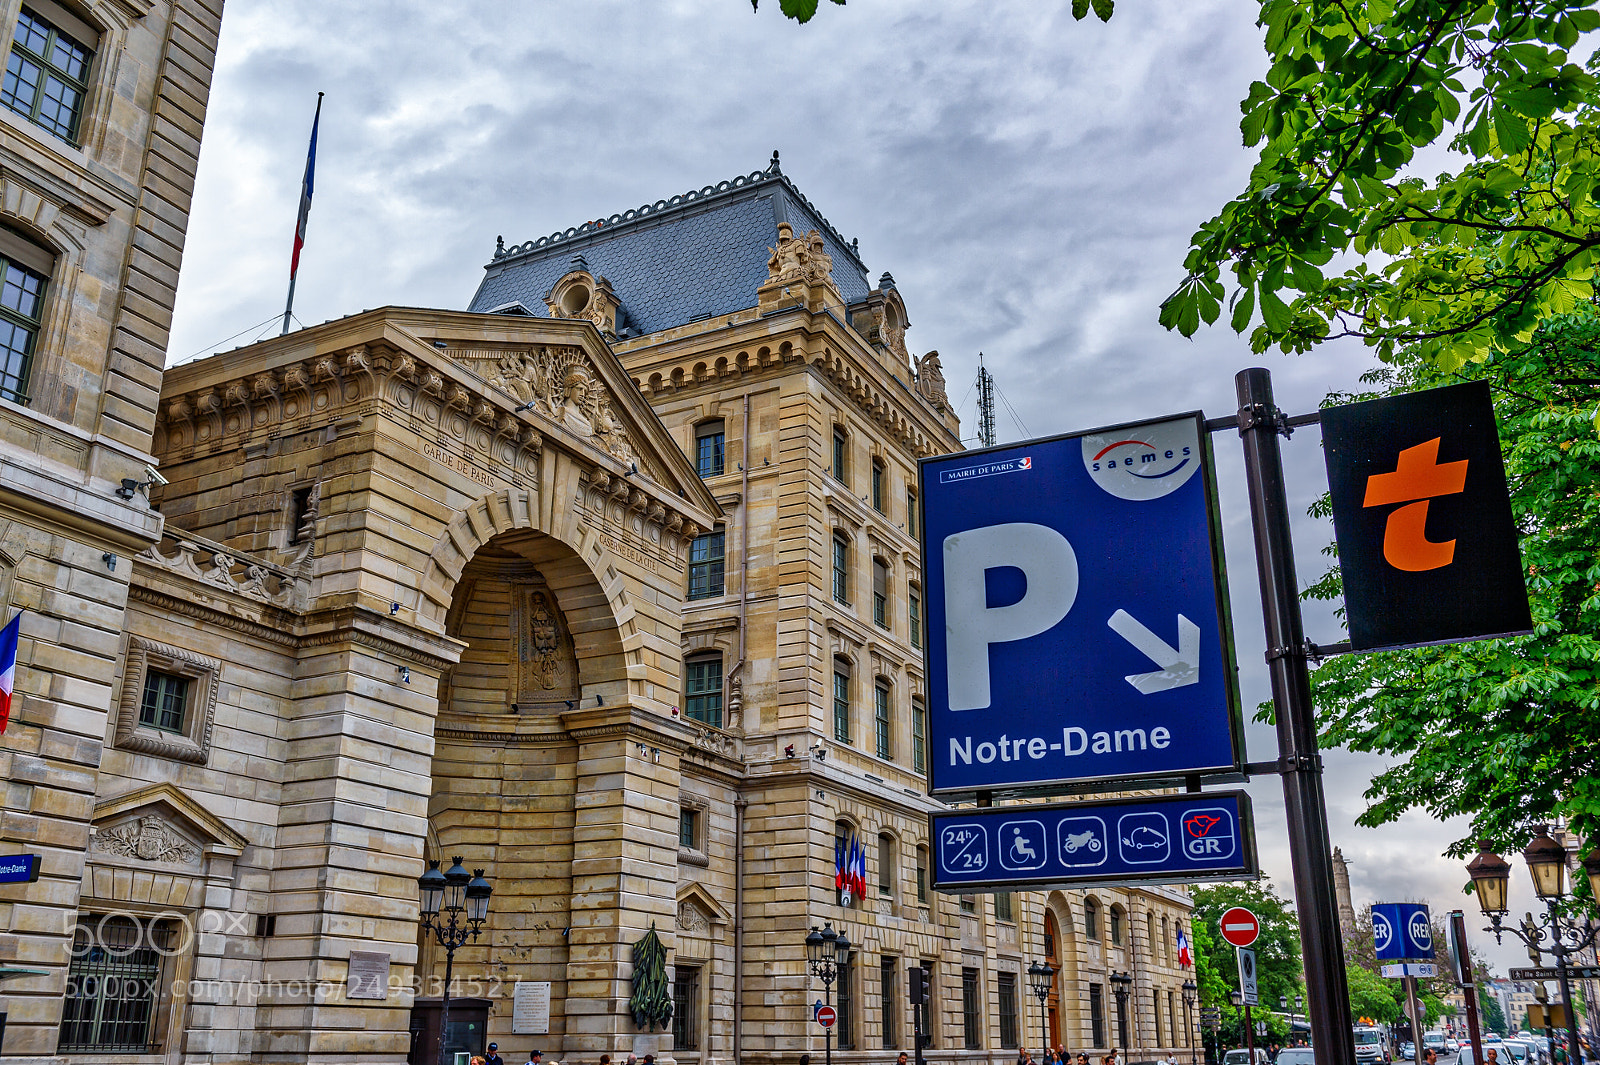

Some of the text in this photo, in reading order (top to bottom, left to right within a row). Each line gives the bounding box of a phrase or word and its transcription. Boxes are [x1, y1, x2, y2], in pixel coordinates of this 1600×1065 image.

[423, 443, 495, 488] GARDE DE PARIS
[948, 462, 1014, 480] MAIRIE DE PARIS
[1092, 446, 1191, 472] saemes
[1362, 436, 1469, 572] t
[599, 534, 627, 555] CASERNE
[626, 548, 636, 560] DE
[636, 552, 644, 564] LA
[943, 522, 1079, 711] P
[949, 725, 1171, 766] Notre-Dame
[1188, 838, 1222, 854] GR
[1412, 922, 1431, 938] RER
